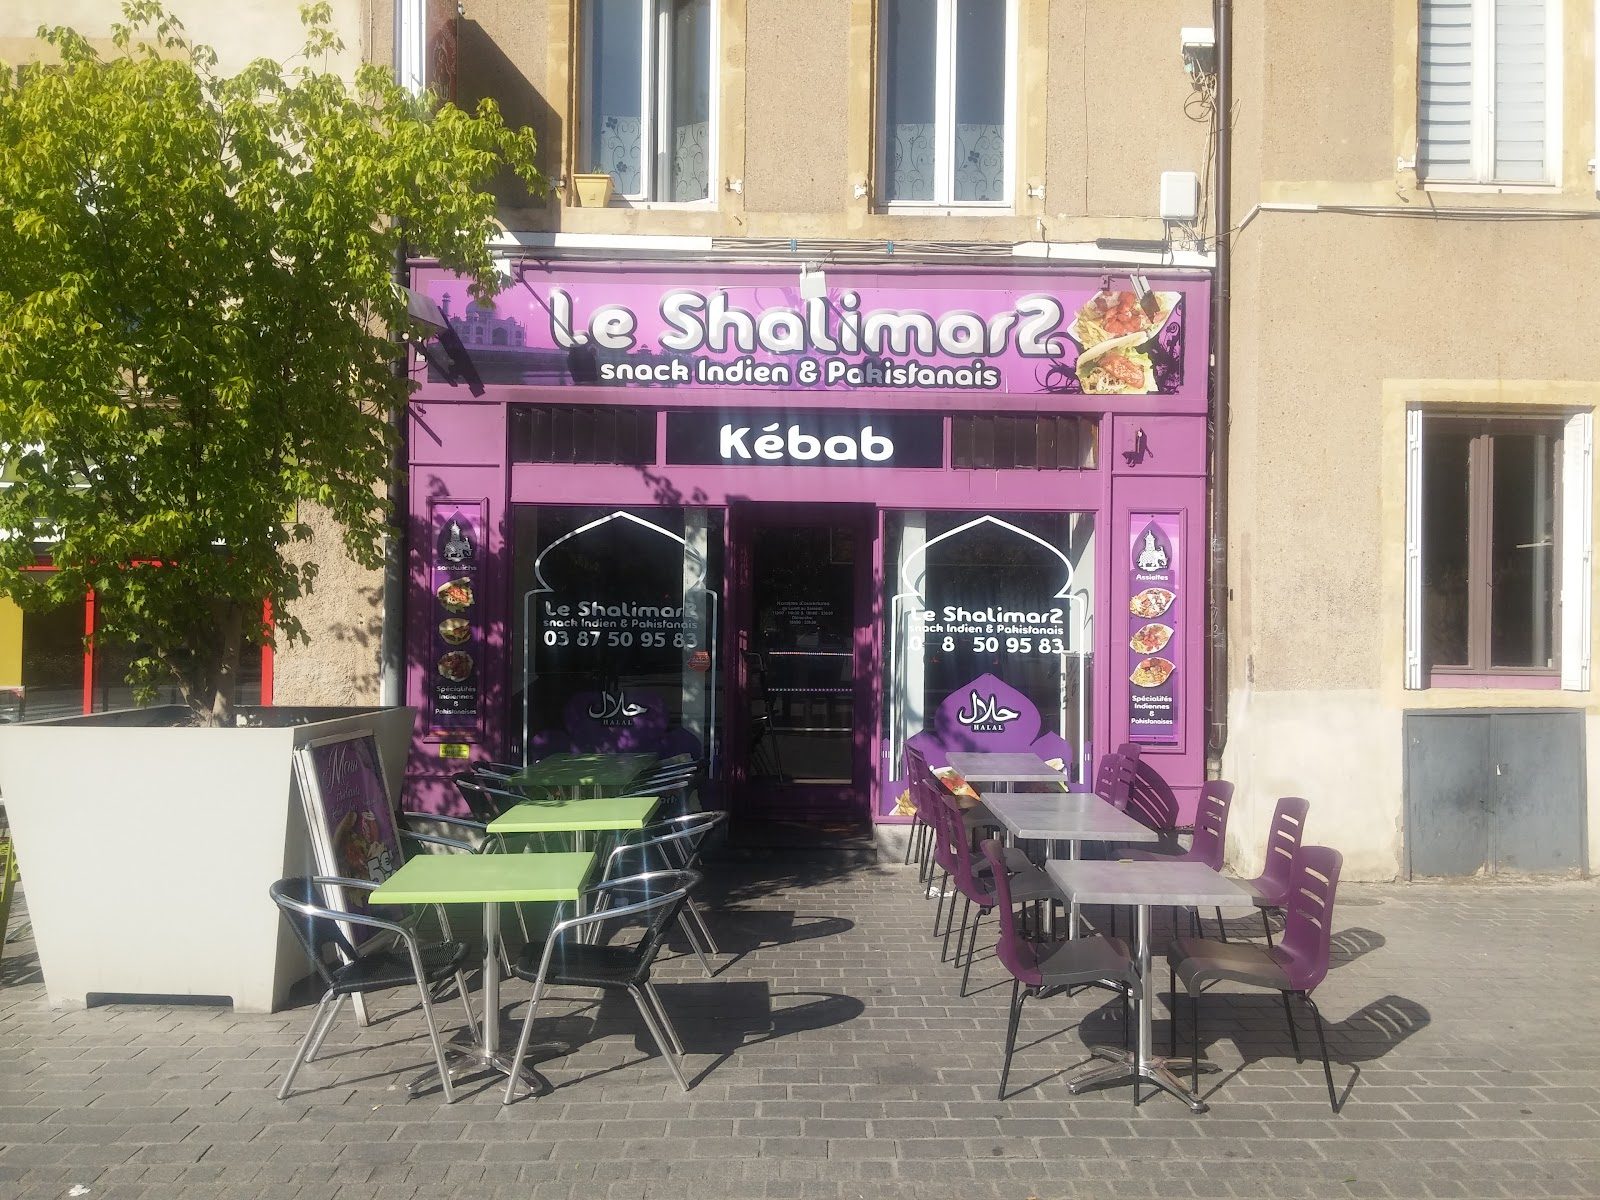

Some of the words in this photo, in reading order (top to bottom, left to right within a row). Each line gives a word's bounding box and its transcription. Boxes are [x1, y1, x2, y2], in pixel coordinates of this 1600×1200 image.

[550, 288, 638, 350] Le
[600, 358, 690, 382] snack
[698, 358, 790, 384] Indien
[798, 360, 819, 384] &
[828, 360, 998, 388] Pakistanais
[719, 422, 895, 462] Kébab
[1135, 573, 1169, 581] Assiettes
[545, 601, 571, 617] Le
[910, 606, 936, 622] Le
[943, 606, 1064, 624] Shalimar2
[543, 618, 579, 628] snack
[581, 618, 618, 629] Indien
[620, 619, 629, 629] &
[631, 619, 698, 630] Pakistanais
[946, 624, 983, 634] Indien
[985, 624, 994, 634] &
[996, 624, 1064, 635] Pakistanais
[543, 630, 570, 647] 03
[576, 631, 601, 647] 87
[607, 631, 634, 648] 50
[640, 632, 666, 648] 95
[672, 633, 699, 649] 83
[972, 637, 999, 653] 50
[1005, 637, 1032, 654] 95
[1038, 638, 1064, 654] 83
[588, 690, 648, 719] حلال
[1131, 694, 1173, 703] Spécialités
[1134, 702, 1170, 710] Indiennes
[958, 691, 1020, 724] حلال
[1131, 717, 1173, 725] Pakistanaises
